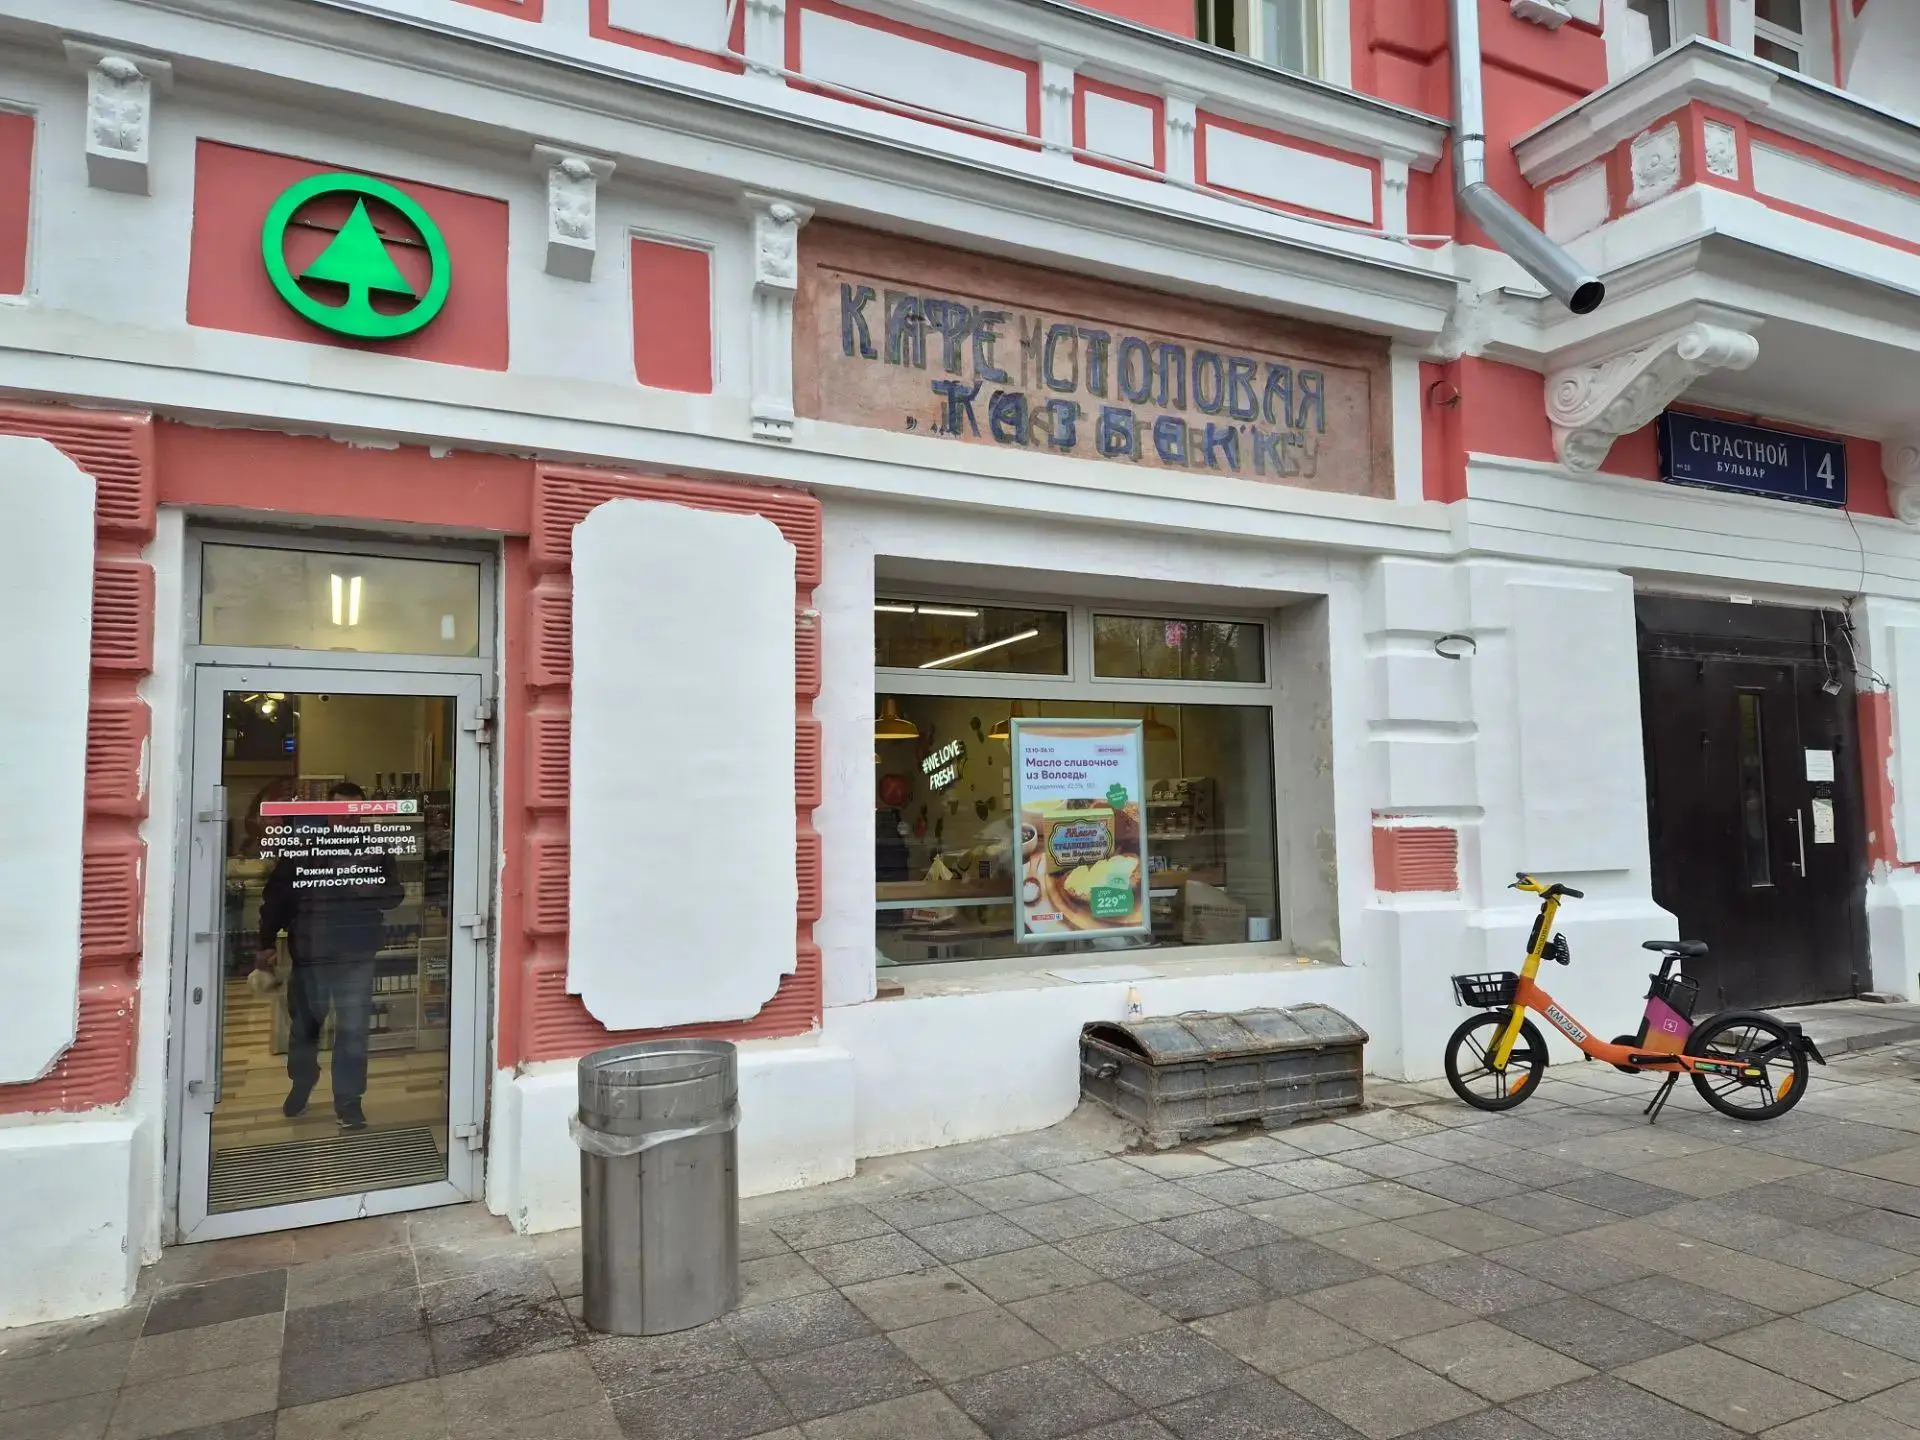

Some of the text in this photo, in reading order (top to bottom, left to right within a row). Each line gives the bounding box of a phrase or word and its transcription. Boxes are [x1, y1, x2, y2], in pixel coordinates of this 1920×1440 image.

[1690, 430, 1835, 489] СТРАСТНОЙ 4
[1717, 461, 1766, 478] БУЛЬВАР
[922, 740, 960, 775] #WE LOVE
[1025, 758, 1119, 768] Масло сливочное
[930, 764, 955, 790] FRESH
[1026, 770, 1087, 781] из Вологды
[348, 803, 397, 812] SPAR
[265, 824, 411, 836] ООО «Спар Миддл Волга»
[260, 835, 416, 848] 603058, г. Нижний Новгород
[260, 851, 275, 859] ул.
[278, 849, 309, 858] Героя
[311, 848, 352, 858] Попова,
[388, 845, 417, 857] оф.15
[296, 866, 383, 877] Режим работы:
[292, 877, 386, 889] КРУГЛОСУТОЧНО
[1097, 896, 1119, 908] 229
